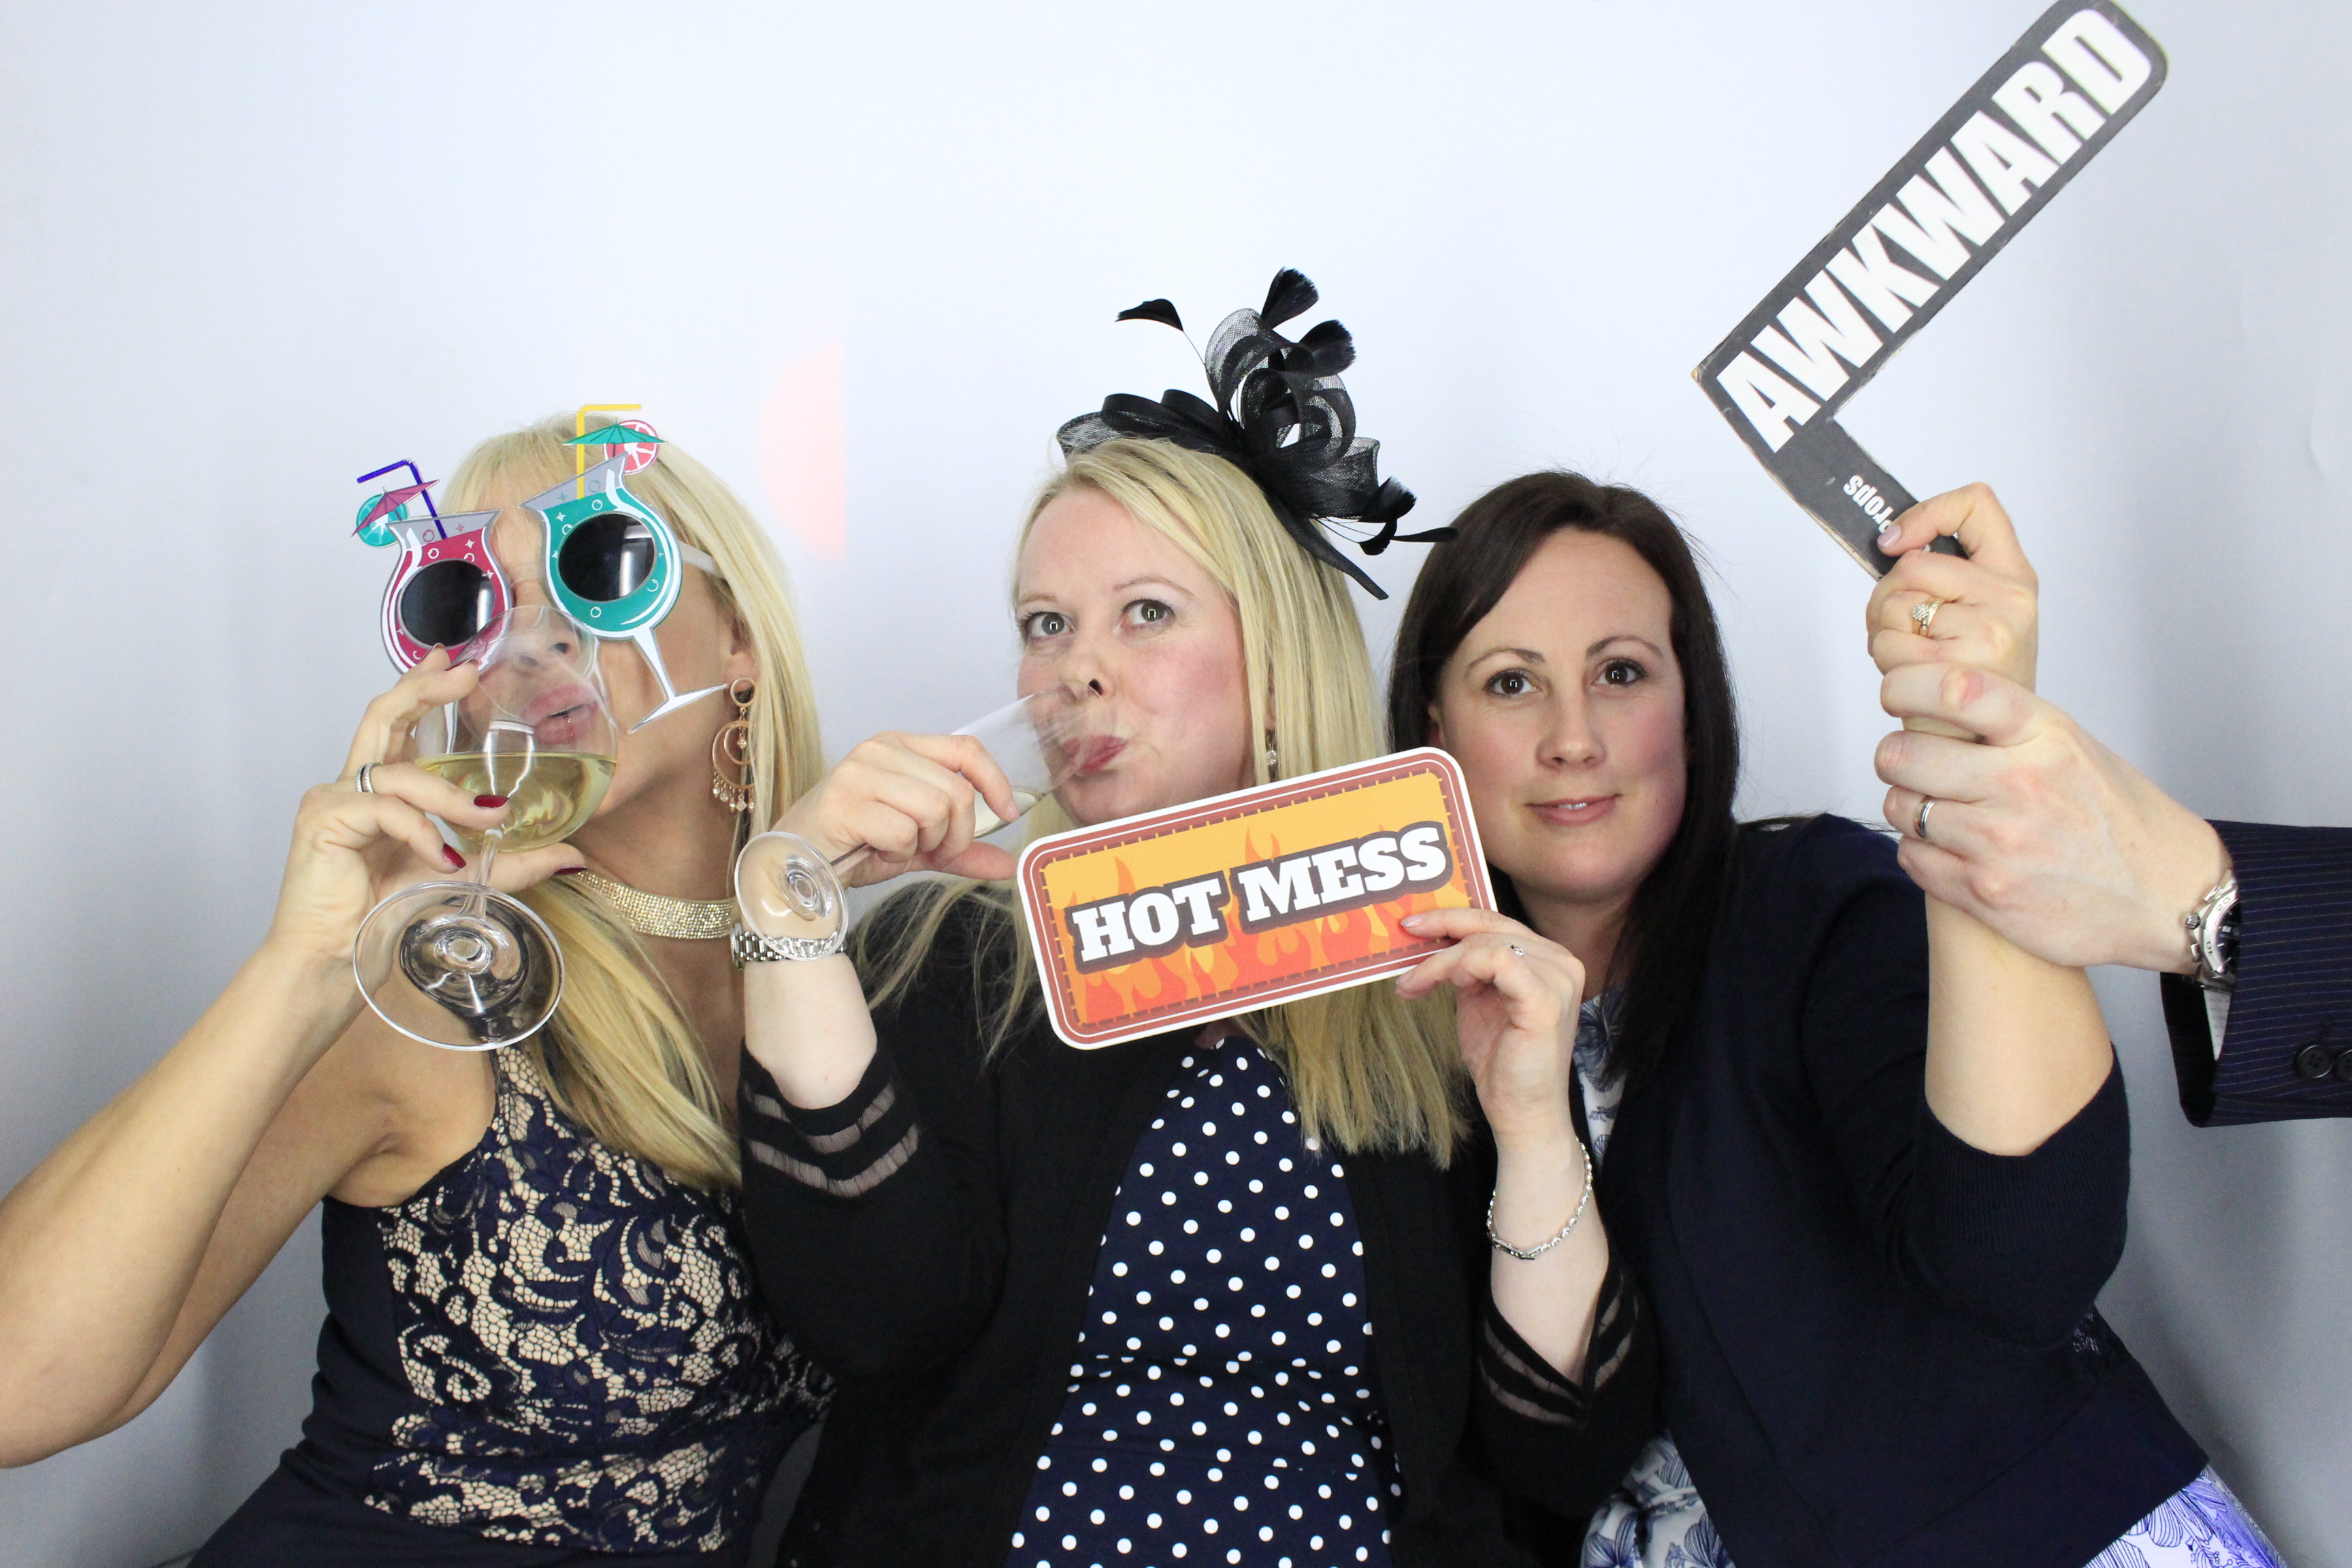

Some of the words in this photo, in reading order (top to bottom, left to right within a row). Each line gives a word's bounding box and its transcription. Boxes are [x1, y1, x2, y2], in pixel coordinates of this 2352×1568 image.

[1716, 9, 2152, 454] AWKWARD
[1072, 878, 1222, 962] HOT
[1237, 827, 1447, 921] MESS
[2216, 897, 2230, 912] 20
